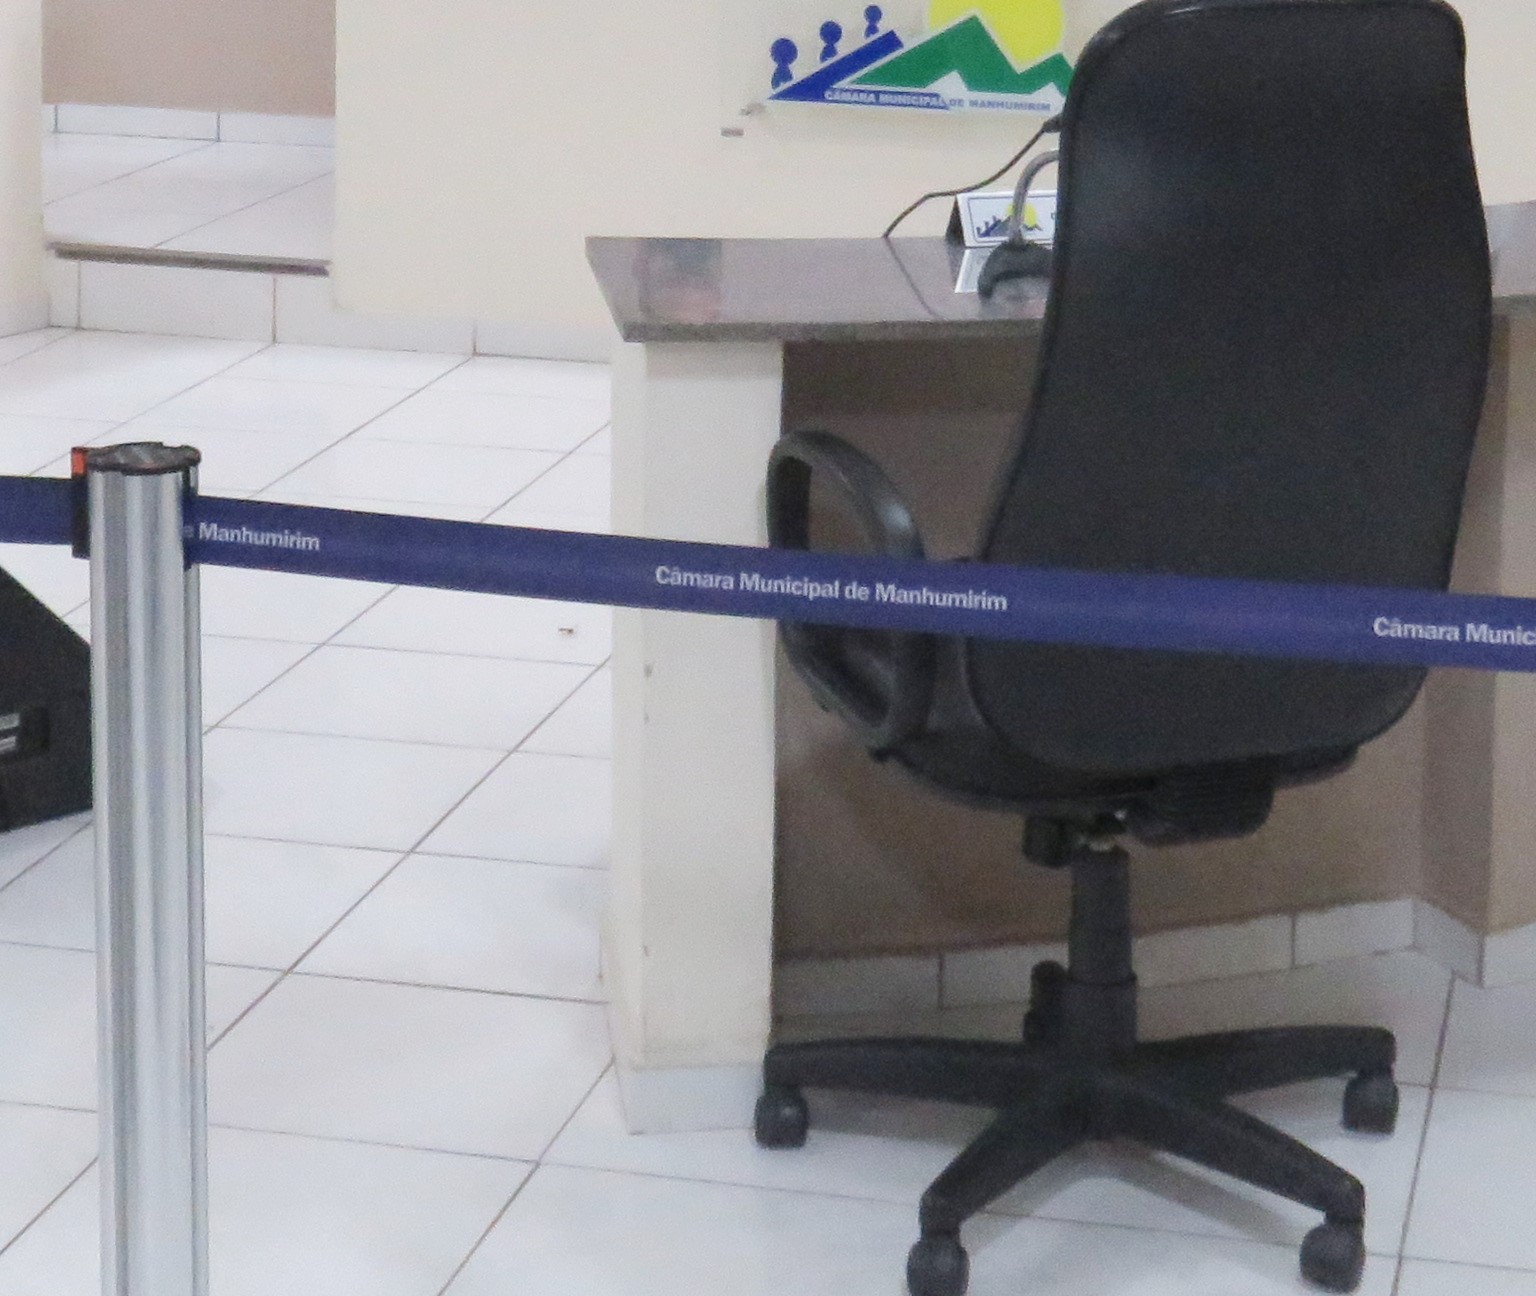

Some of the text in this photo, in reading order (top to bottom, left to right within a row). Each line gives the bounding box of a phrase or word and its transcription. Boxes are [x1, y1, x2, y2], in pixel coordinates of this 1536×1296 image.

[879, 92, 947, 107] MUNICIPAL
[199, 522, 321, 550] Manhumirim
[655, 566, 1008, 611] Câmara Municipal de Manhumirim
[1373, 616, 1460, 641] Câmara
